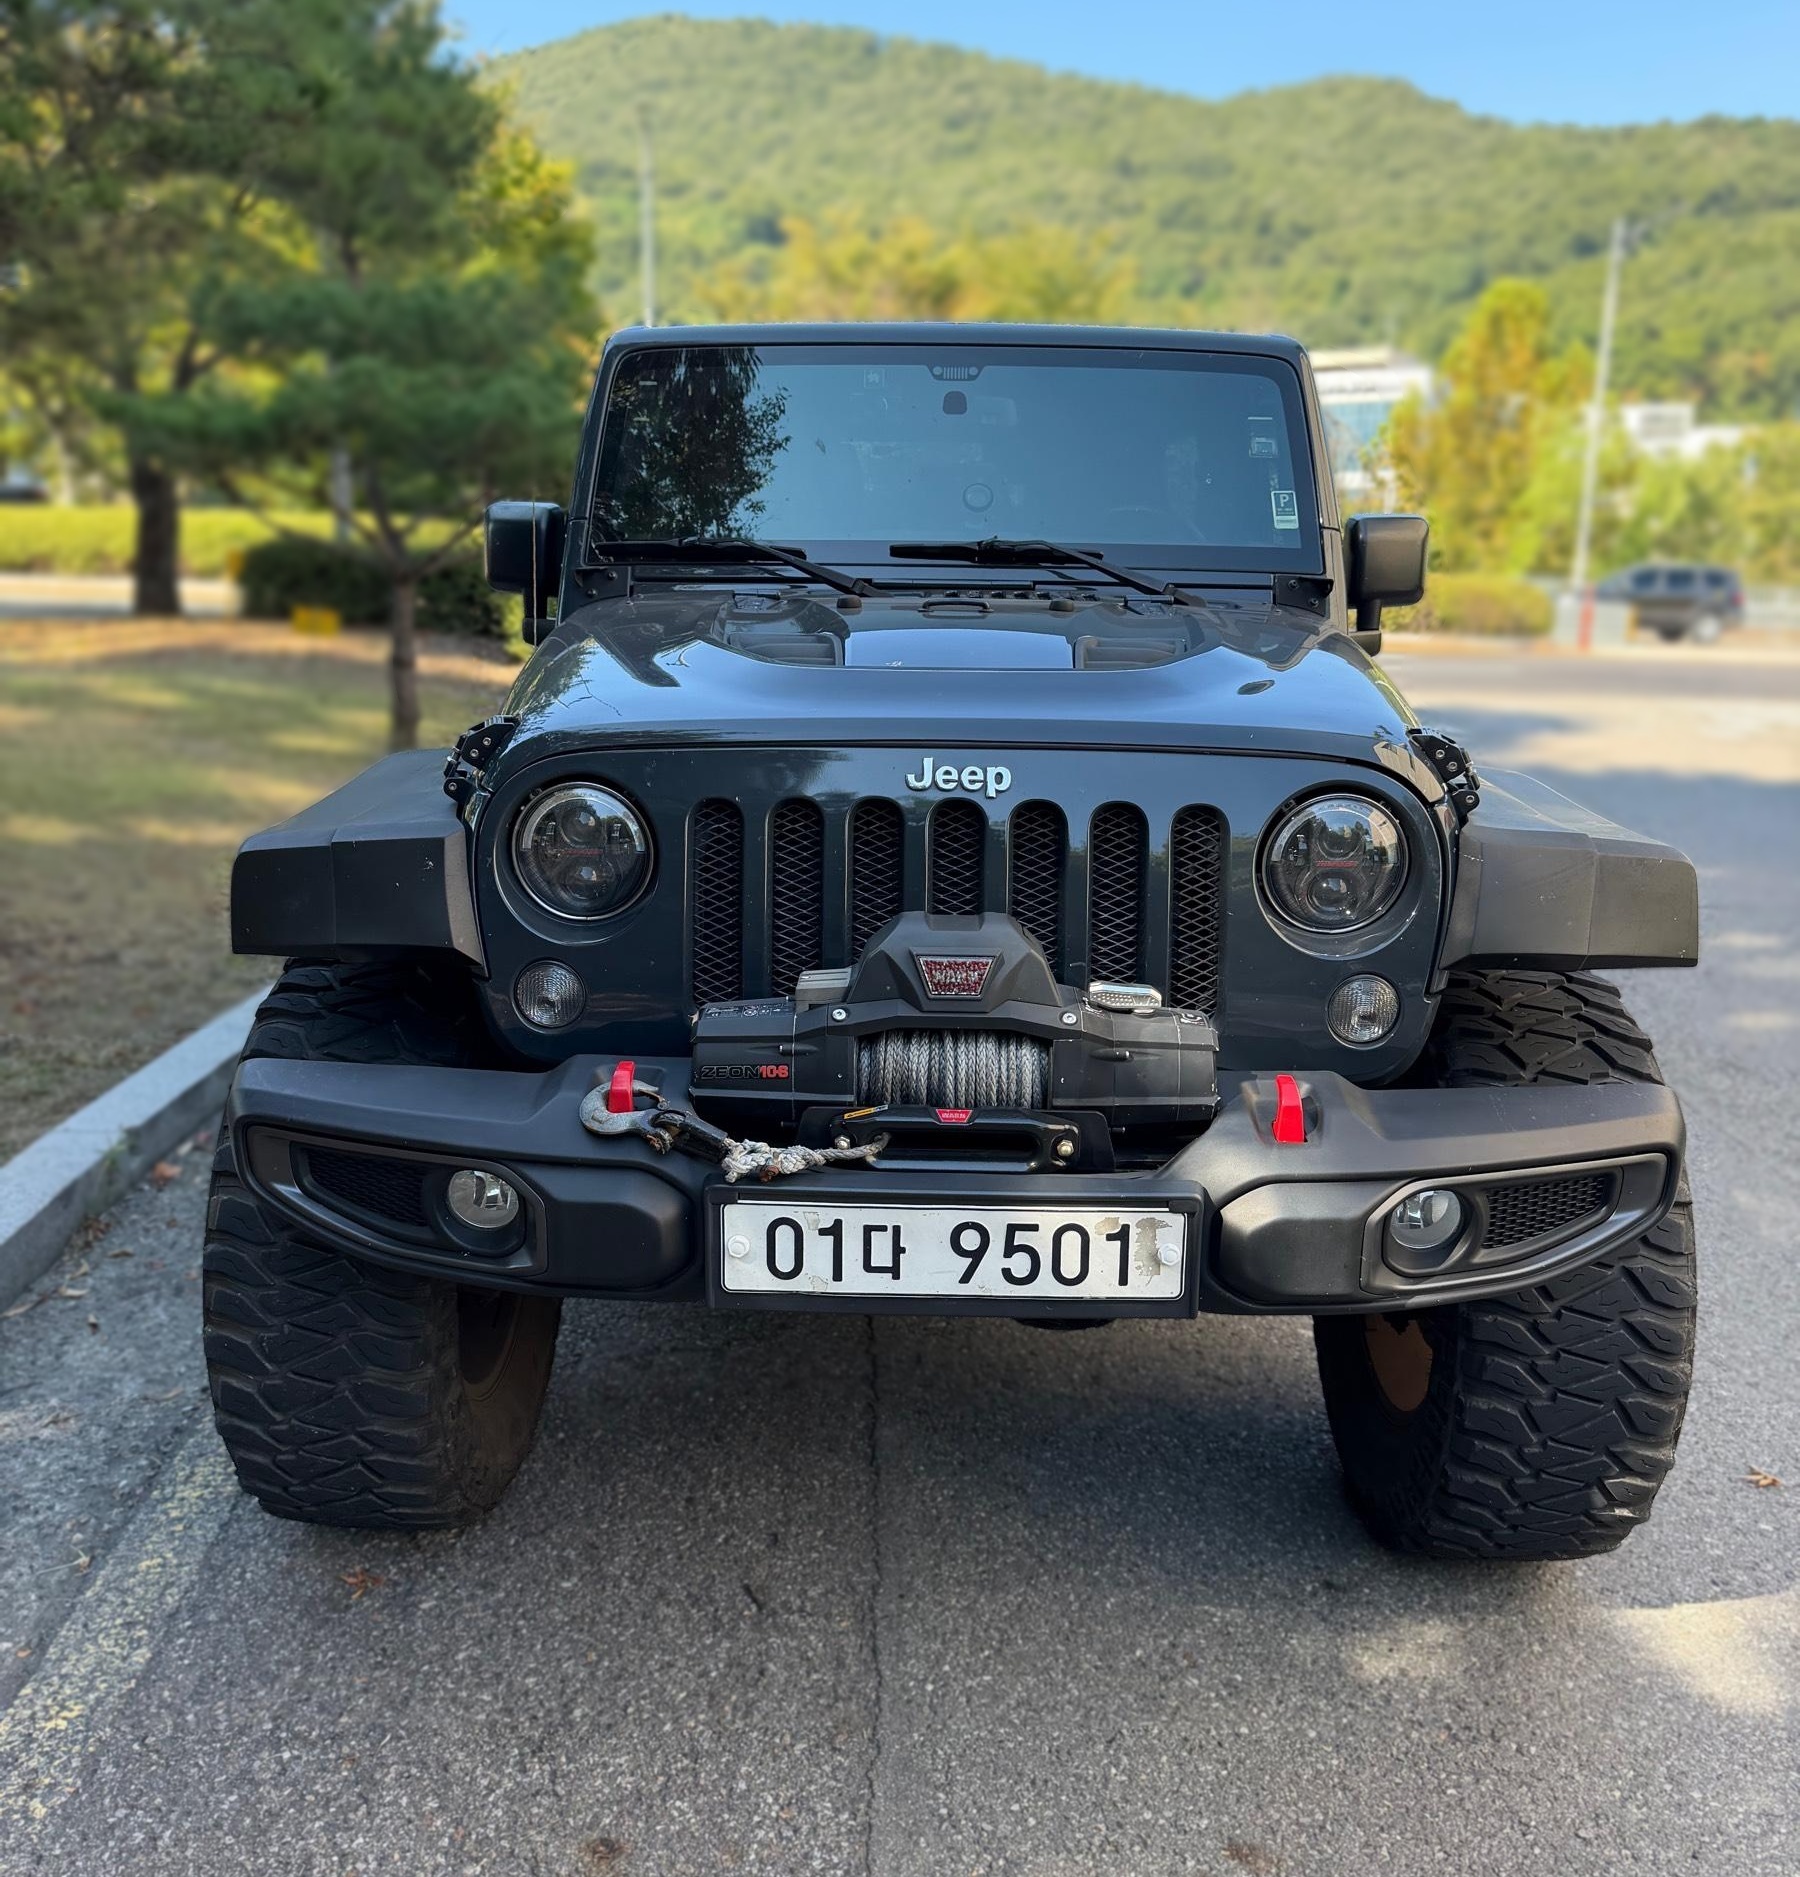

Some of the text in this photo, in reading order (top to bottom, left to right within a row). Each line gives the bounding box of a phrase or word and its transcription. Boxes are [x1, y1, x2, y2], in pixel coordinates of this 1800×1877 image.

[1279, 494, 1289, 507] P
[905, 757, 1012, 798] Jeep
[766, 1216, 1131, 1286] 01다 9501
